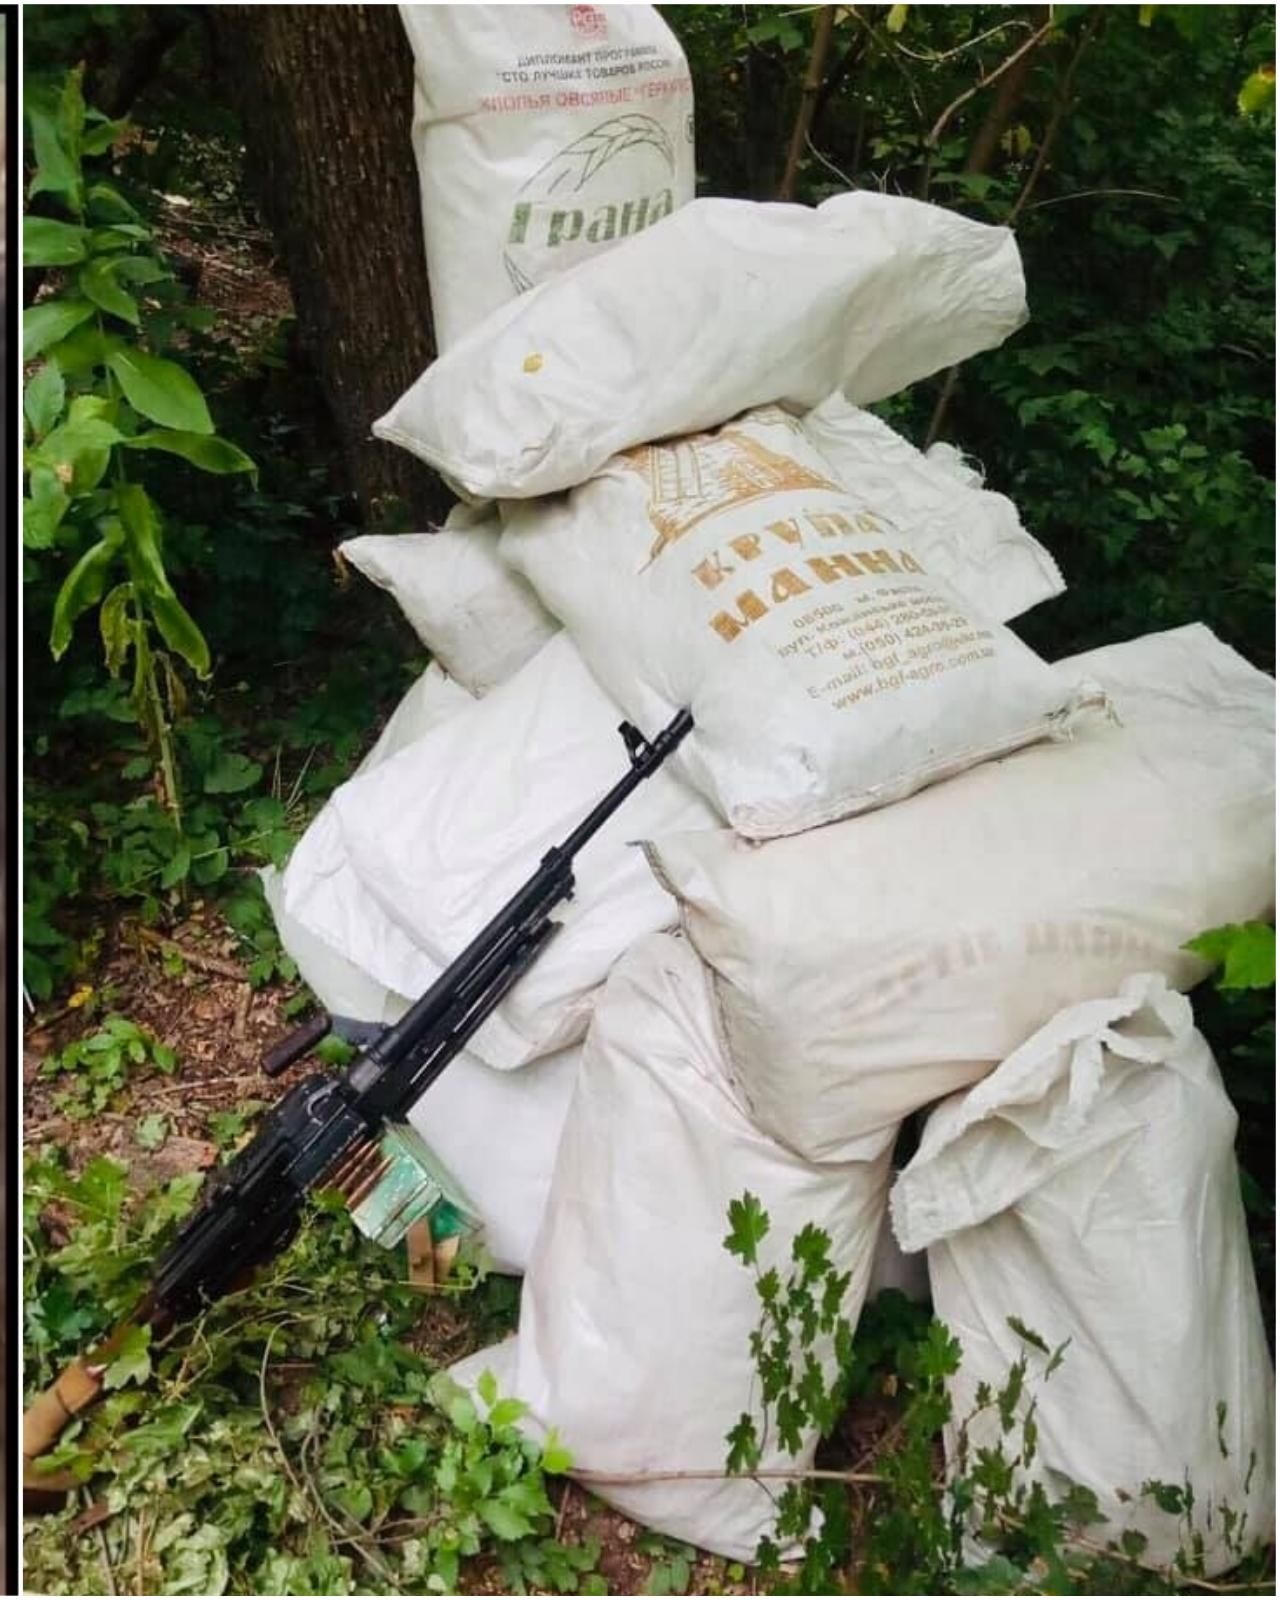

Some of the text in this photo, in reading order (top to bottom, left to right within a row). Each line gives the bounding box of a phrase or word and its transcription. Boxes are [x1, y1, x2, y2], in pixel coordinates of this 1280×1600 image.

[508, 188, 674, 248] Грана
[690, 506, 884, 590] КРУПА
[708, 549, 928, 643] МАННА
